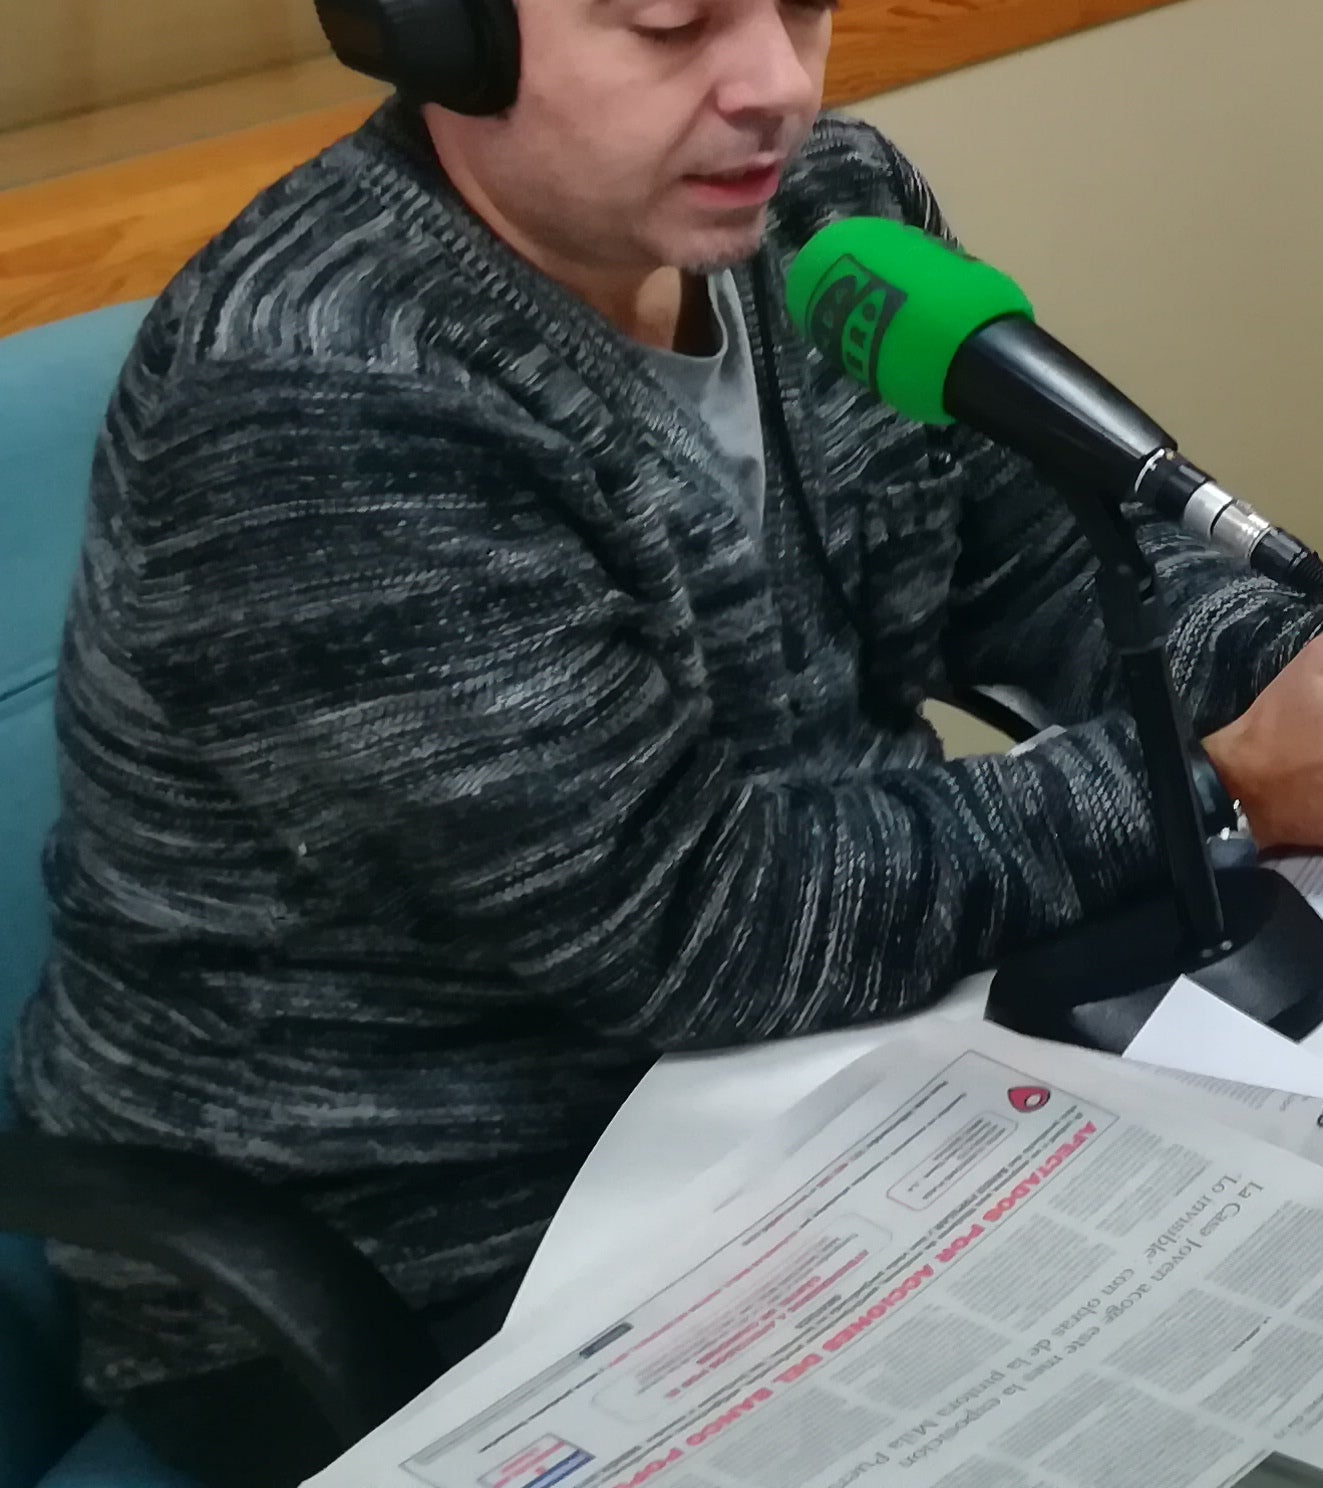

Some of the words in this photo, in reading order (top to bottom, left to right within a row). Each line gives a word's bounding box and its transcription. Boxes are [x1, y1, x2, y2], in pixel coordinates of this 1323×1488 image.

[983, 1121, 1097, 1223] AFECTADOS
[1238, 1180, 1265, 1202] La
[1199, 1201, 1242, 1239] Casa
[935, 1223, 985, 1263] POR
[1150, 1239, 1203, 1282] Joven
[1102, 1266, 1136, 1296] con
[822, 1264, 935, 1352] ACCIONES
[1050, 1296, 1102, 1339] obras
[1103, 1282, 1153, 1326] acoge
[1029, 1337, 1053, 1358] de
[1065, 1325, 1102, 1355] este
